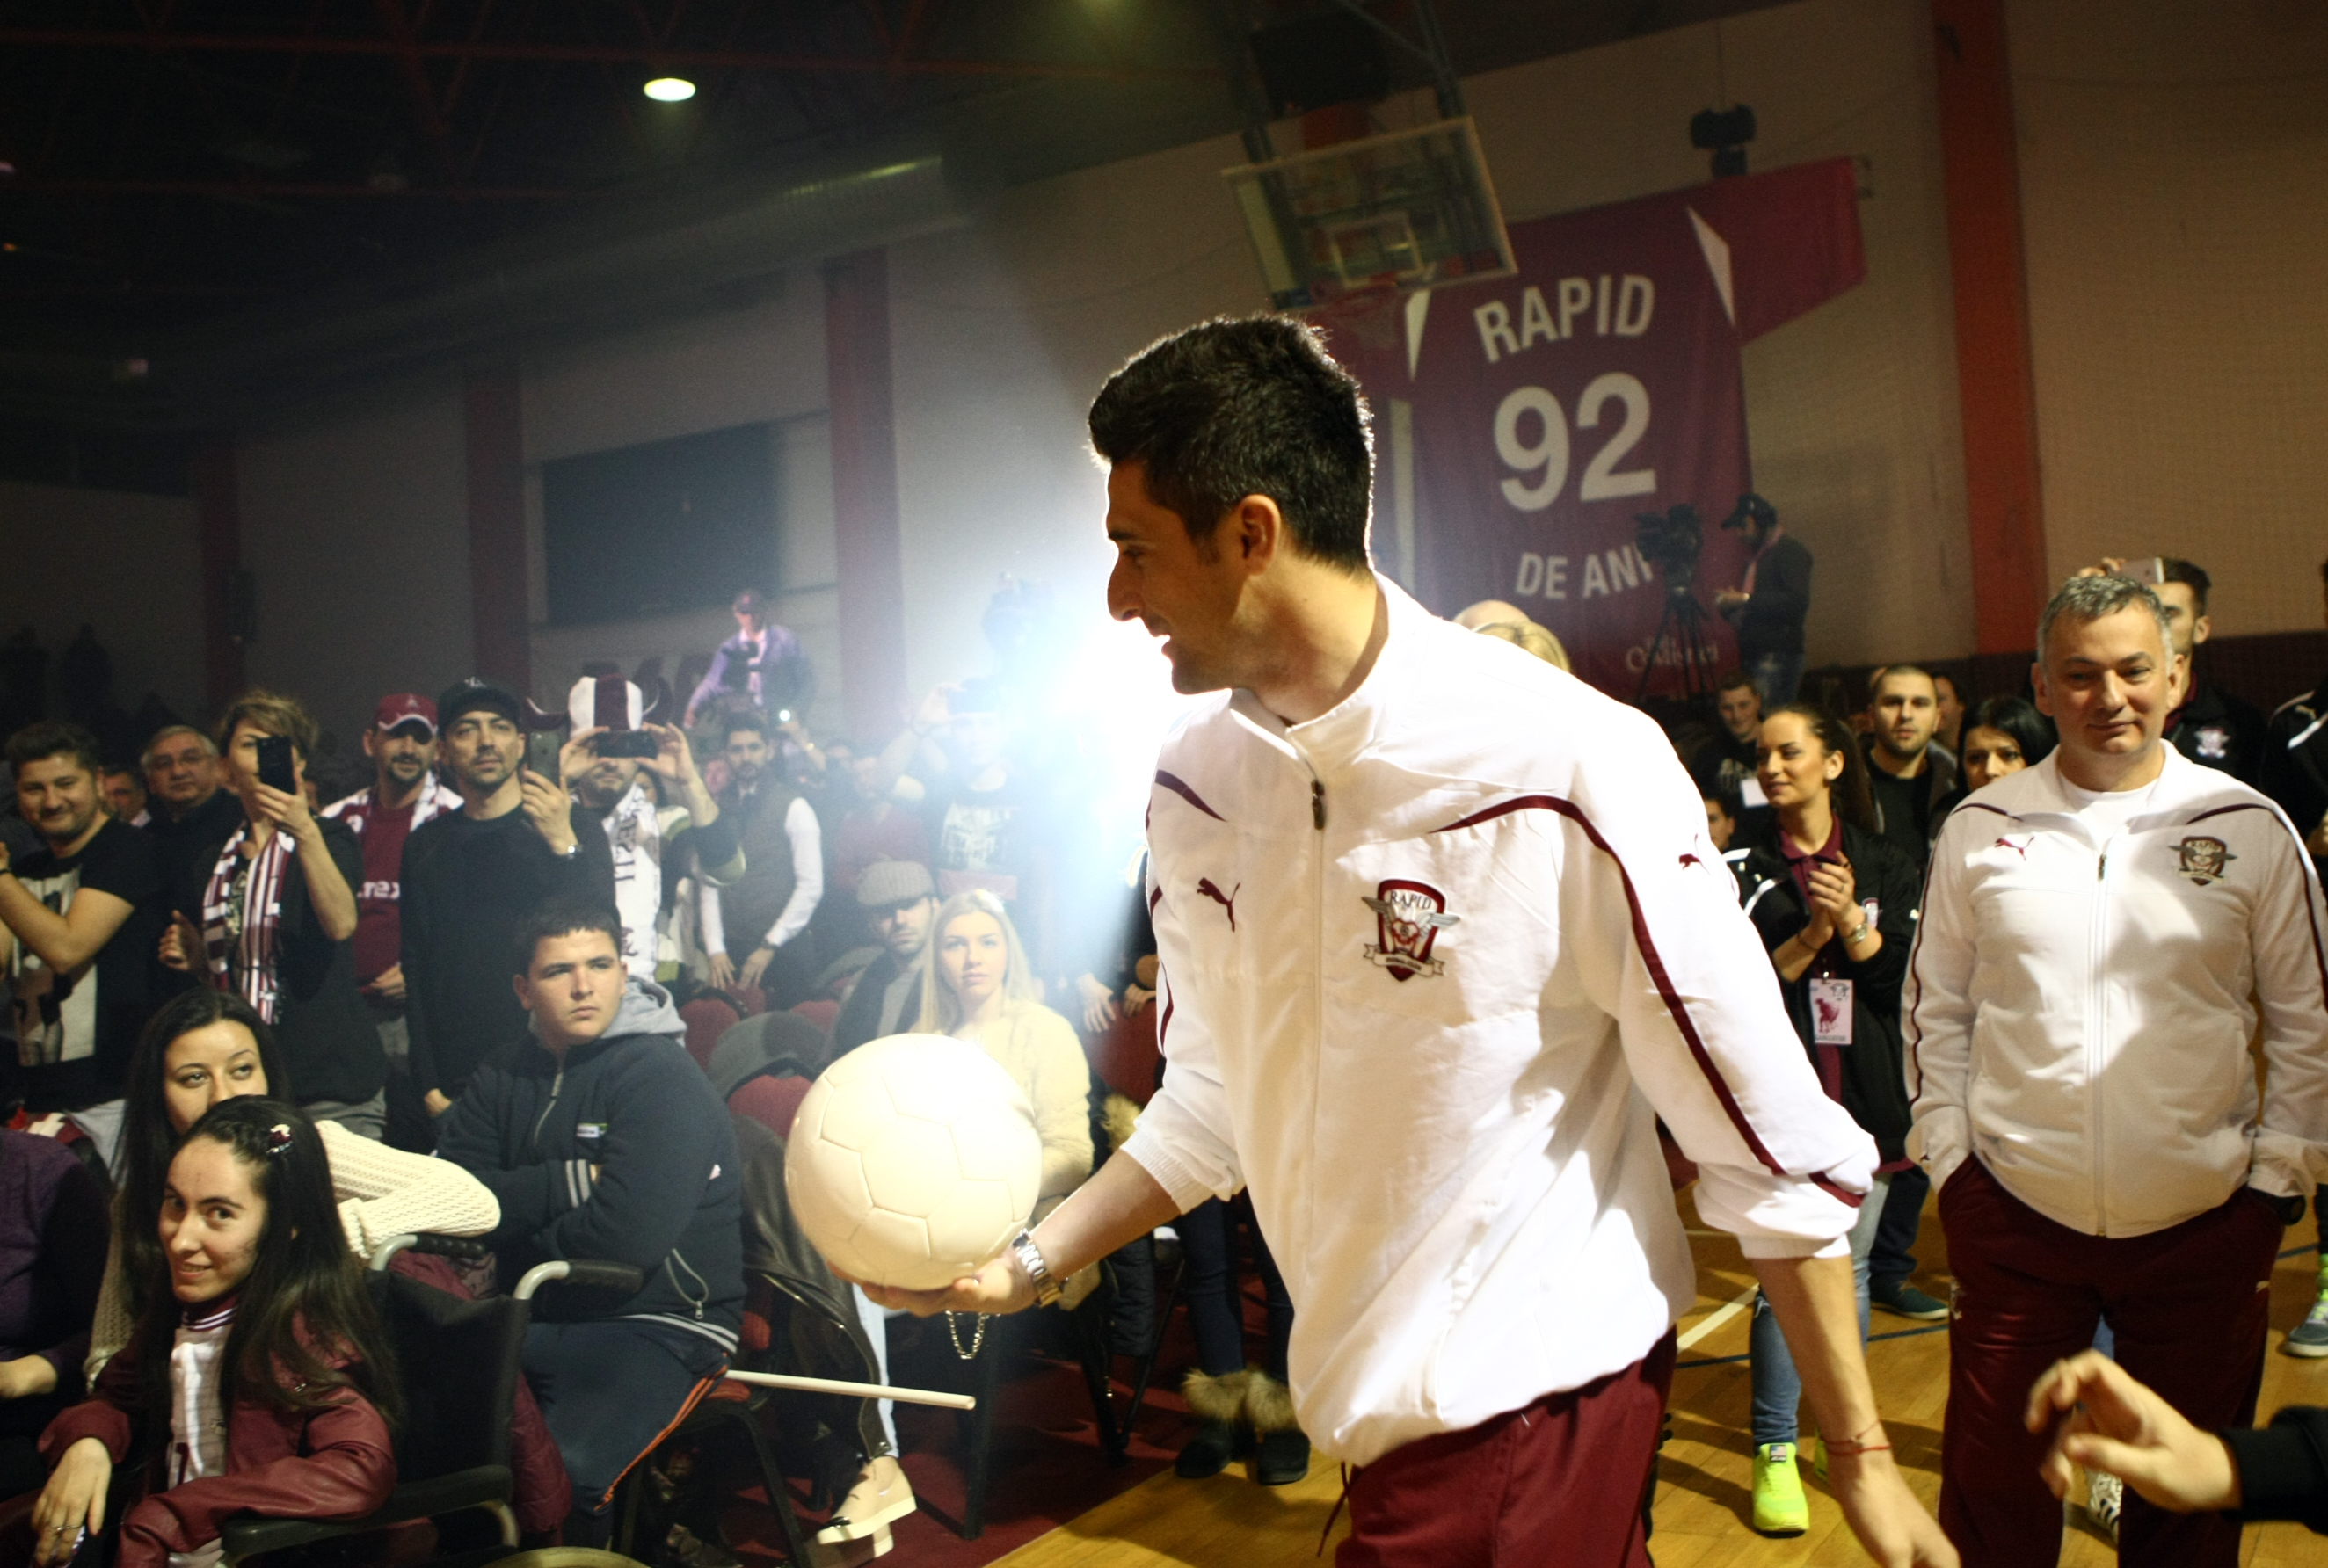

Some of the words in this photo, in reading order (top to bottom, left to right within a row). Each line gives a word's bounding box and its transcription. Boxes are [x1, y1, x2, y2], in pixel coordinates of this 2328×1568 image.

[1474, 274, 1655, 363] RAPID
[1495, 372, 1656, 512] 92
[1515, 551, 1568, 600] DE
[1389, 889, 1432, 910] RAPID
